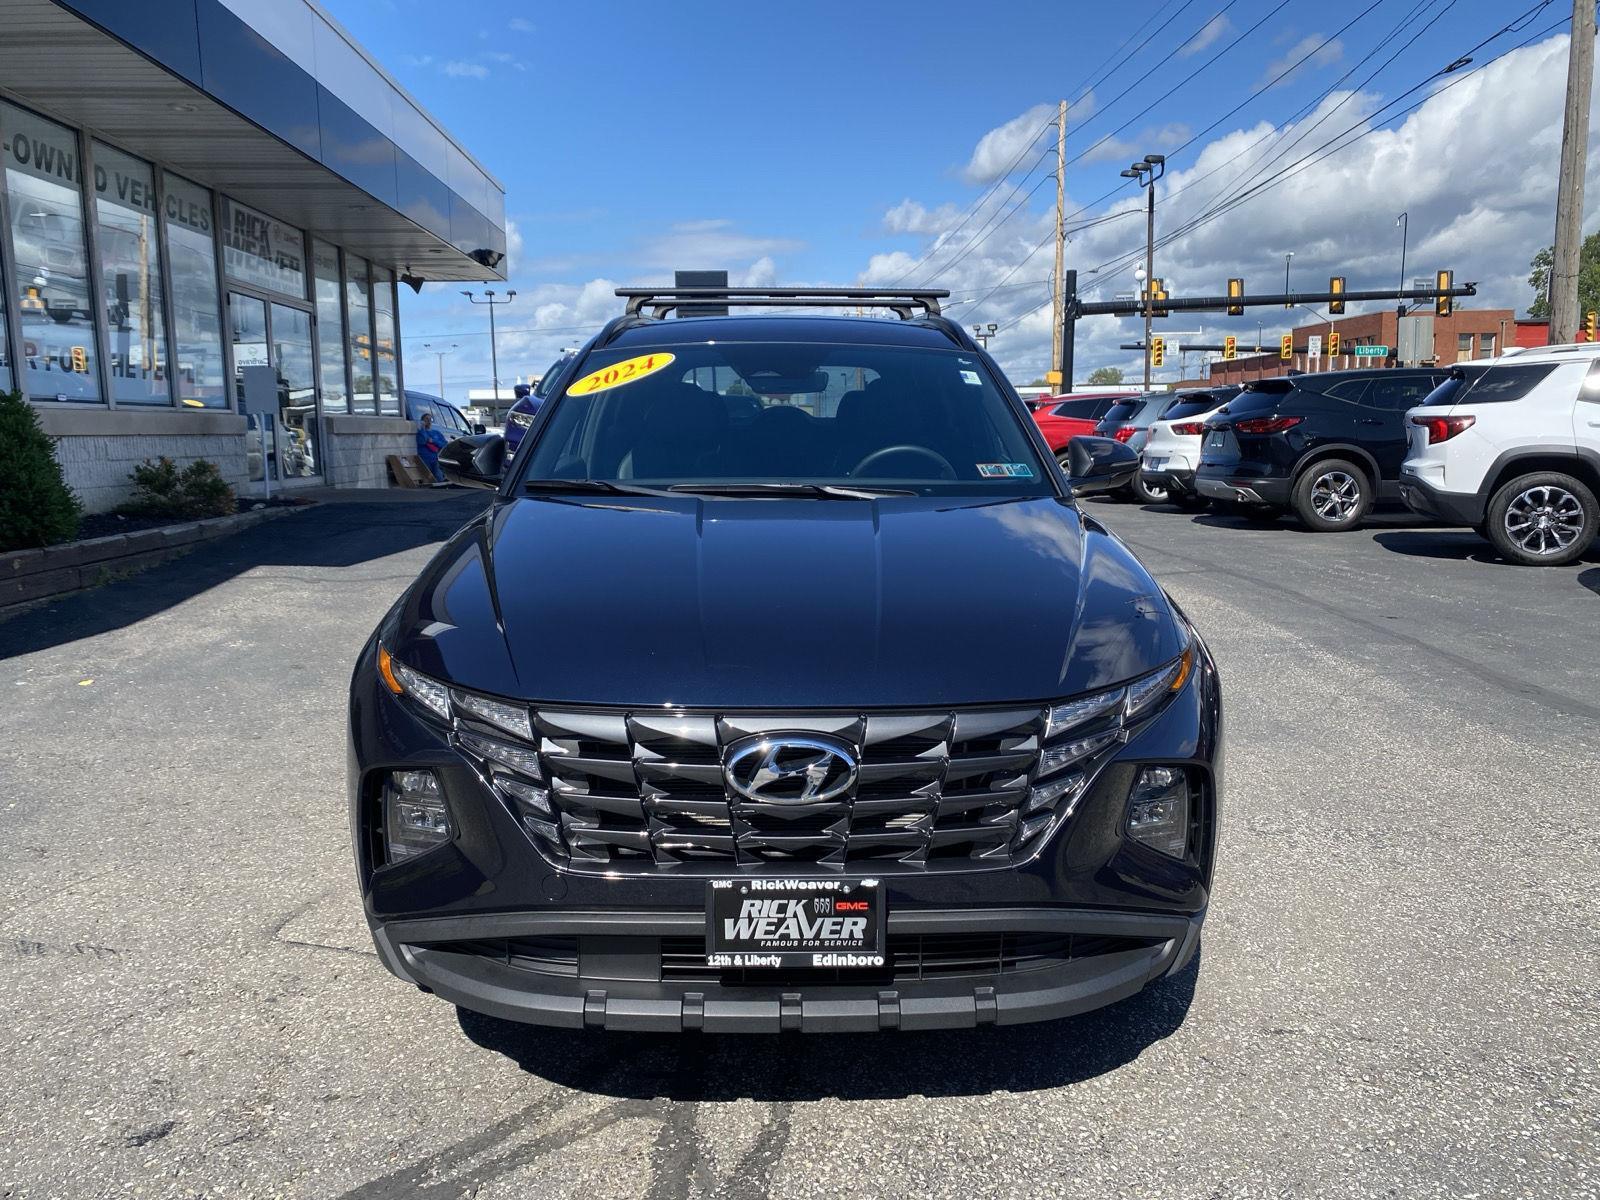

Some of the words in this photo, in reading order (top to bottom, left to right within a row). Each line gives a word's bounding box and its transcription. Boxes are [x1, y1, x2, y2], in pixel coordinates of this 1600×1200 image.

[3, 133, 108, 193] -OWND
[115, 171, 209, 231] VEHCLES
[234, 208, 272, 245] RICK
[1359, 347, 1384, 356] Liberty
[587, 357, 654, 392] 2024
[713, 880, 732, 889] GMC
[751, 880, 841, 891] RickWeaver
[740, 899, 808, 918] RICK
[836, 902, 869, 910] GMC
[724, 917, 867, 940] WEAVER
[708, 955, 731, 966] 12th
[734, 955, 743, 966] &
[744, 955, 782, 968] Liberty
[812, 954, 884, 966] Edinboro
